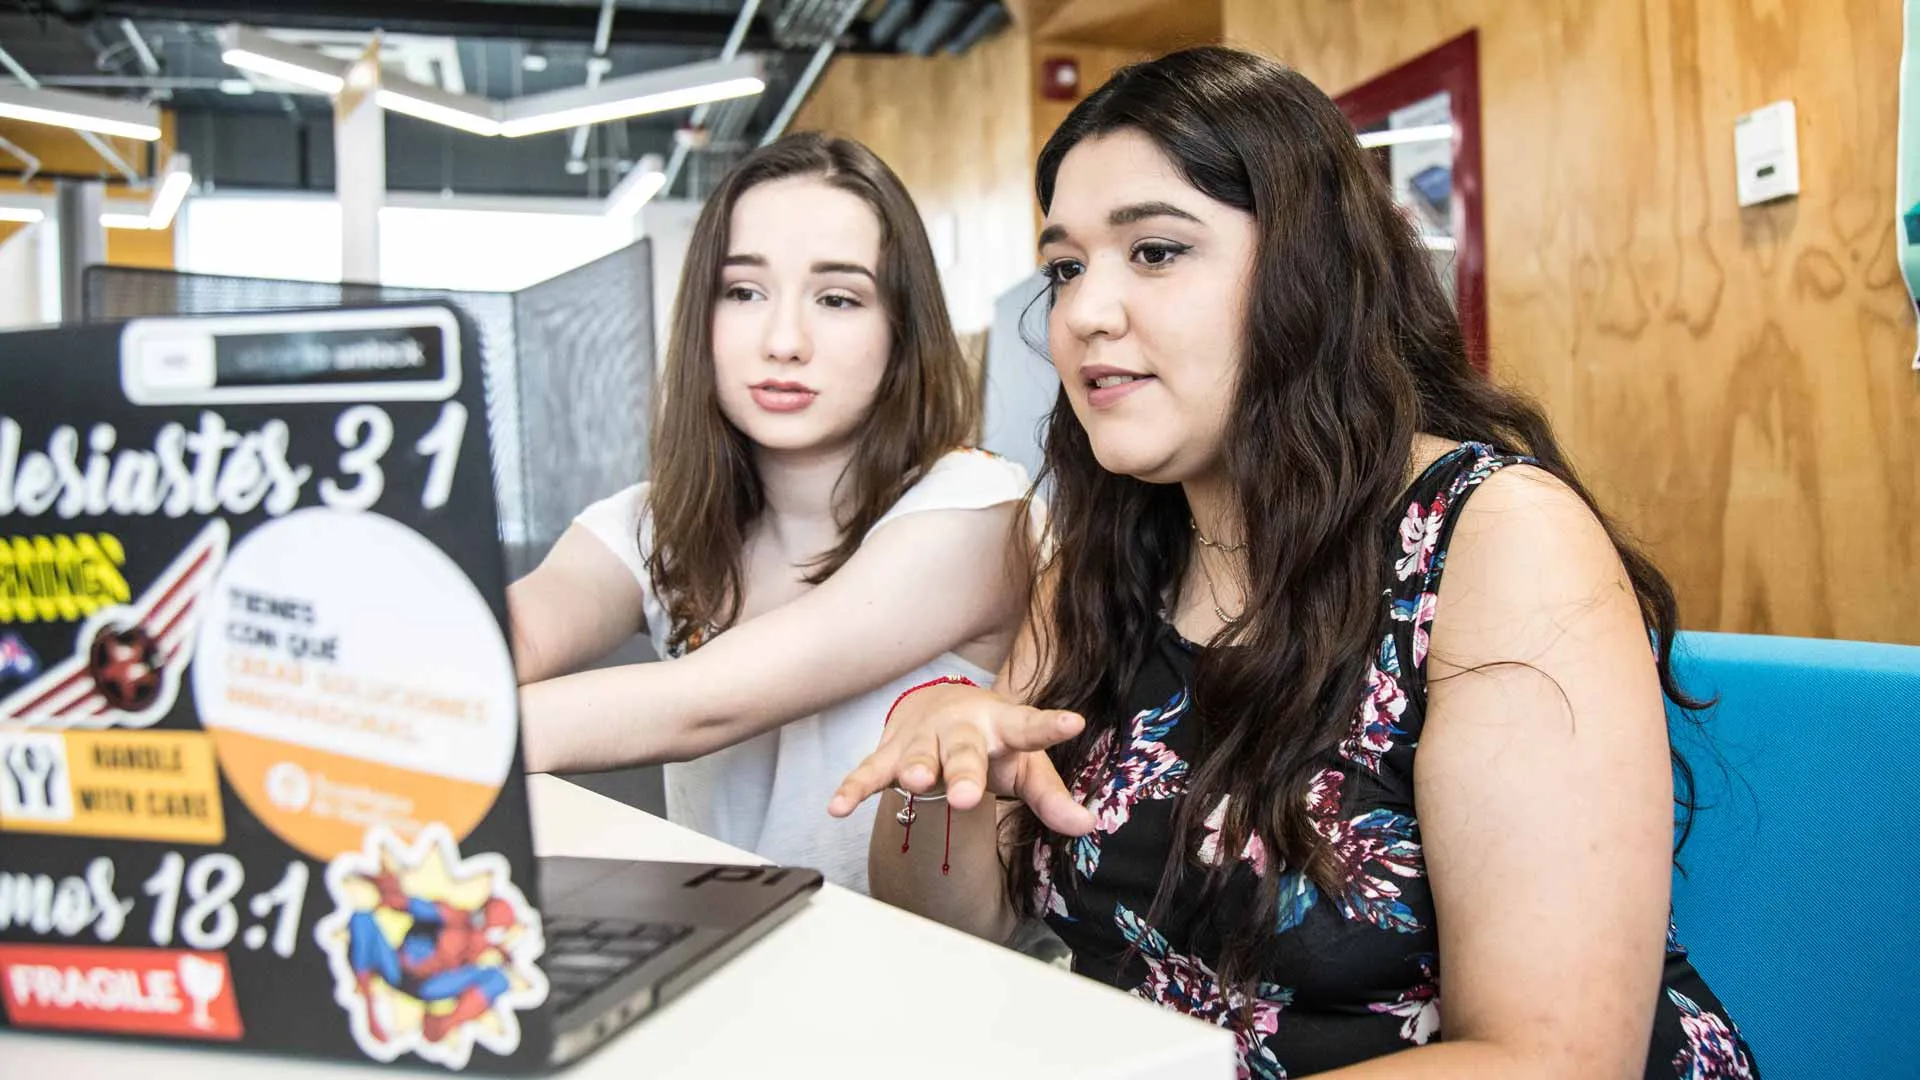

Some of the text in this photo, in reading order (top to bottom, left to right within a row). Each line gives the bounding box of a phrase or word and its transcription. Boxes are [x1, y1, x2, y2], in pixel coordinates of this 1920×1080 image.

[318, 404, 395, 512] 3
[415, 400, 469, 510] 1
[225, 621, 278, 649] CON
[92, 742, 185, 775] HANDLE
[79, 786, 210, 822] WITH CARE
[142, 850, 310, 959] 18:1
[9, 963, 185, 1014] FRAGILE
